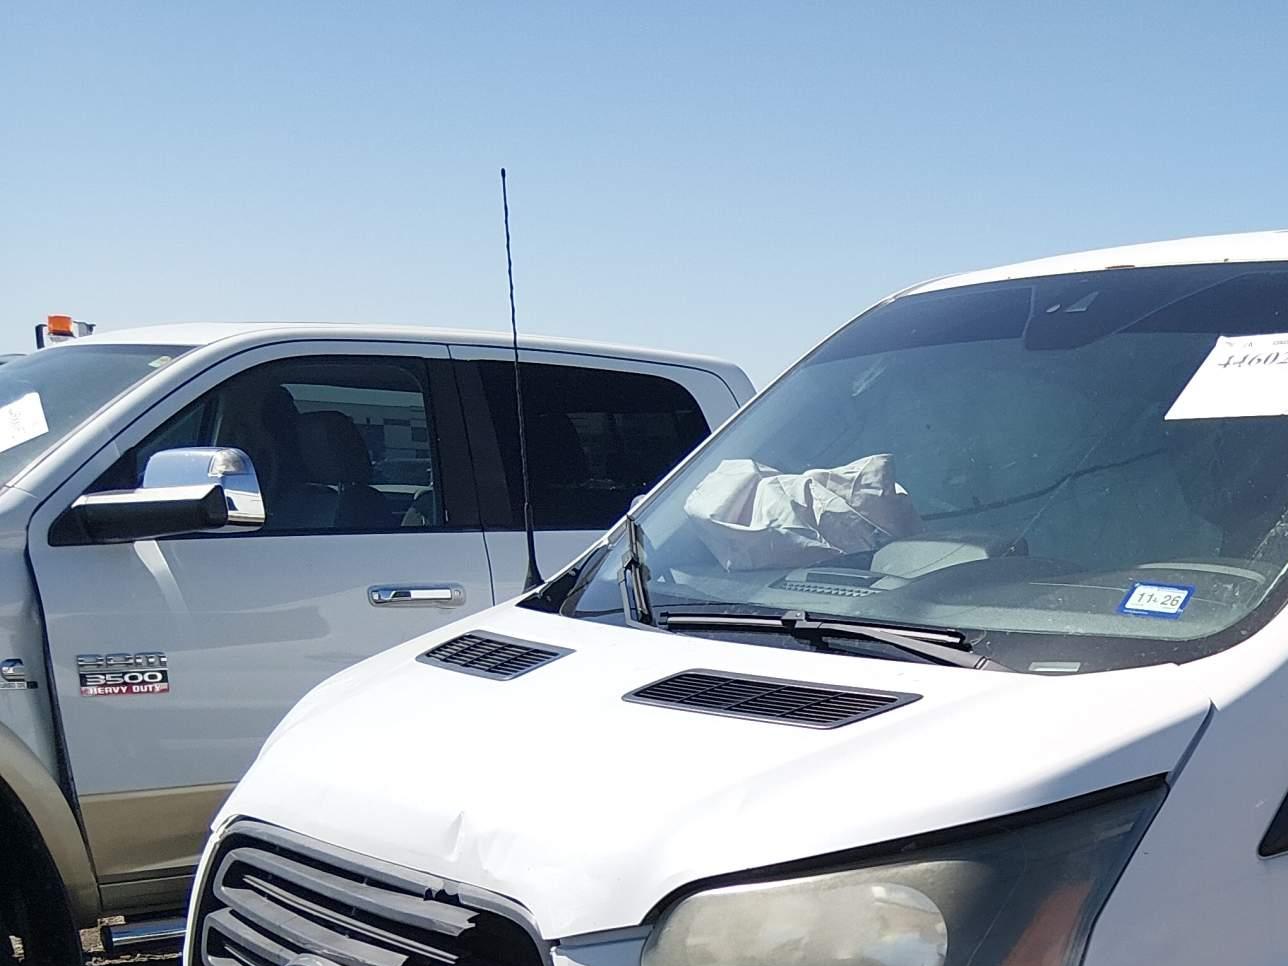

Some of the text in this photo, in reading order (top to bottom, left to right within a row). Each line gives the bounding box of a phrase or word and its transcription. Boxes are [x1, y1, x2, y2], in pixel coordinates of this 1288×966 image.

[1160, 594, 1181, 607] 26
[85, 672, 163, 685] 3500
[89, 684, 161, 695] HEAVY DUTY
